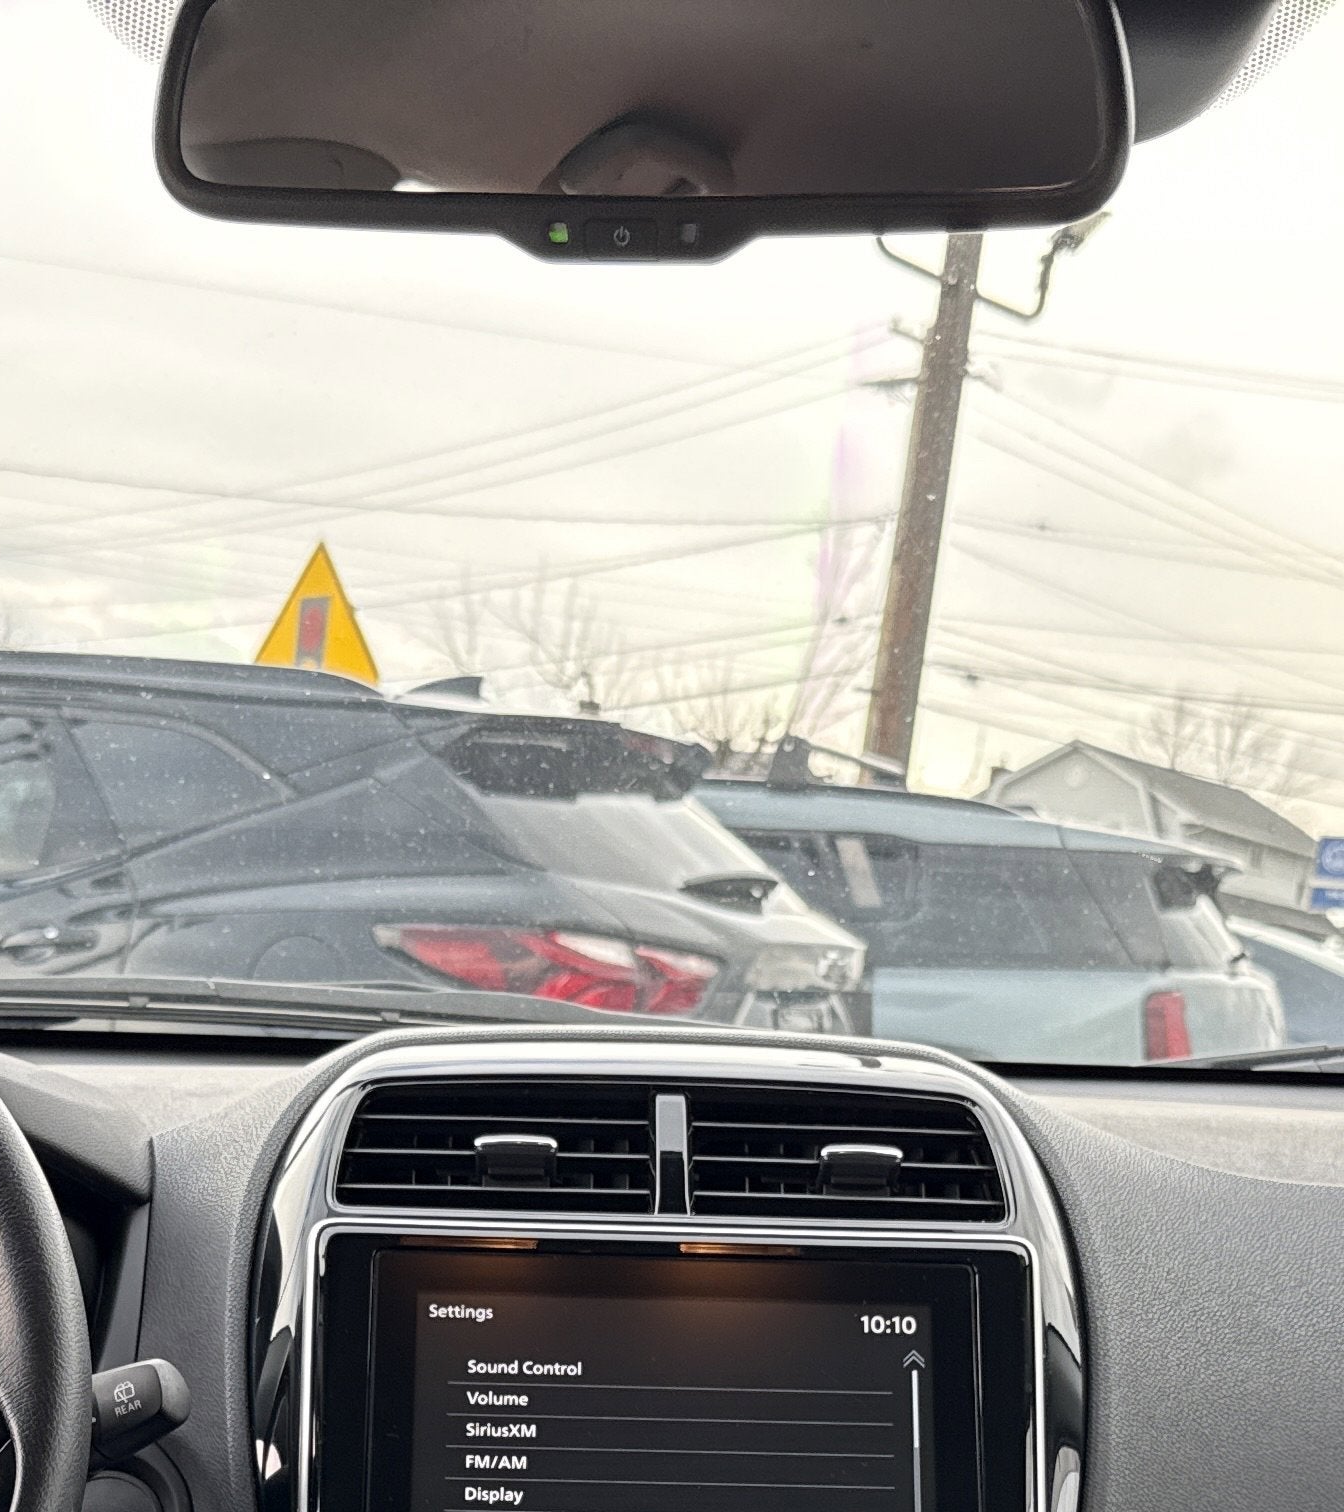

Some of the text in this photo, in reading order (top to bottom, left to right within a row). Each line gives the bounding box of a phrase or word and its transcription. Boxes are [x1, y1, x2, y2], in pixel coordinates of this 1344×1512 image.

[429, 1303, 494, 1323] Settings
[860, 1315, 917, 1335] 10:10
[467, 1359, 582, 1376] Sound Control
[466, 1390, 529, 1407] Volume
[114, 1399, 142, 1418] REAR
[465, 1422, 537, 1438] SiriusXM
[465, 1454, 528, 1470] FM/AM
[463, 1486, 524, 1506] Display
